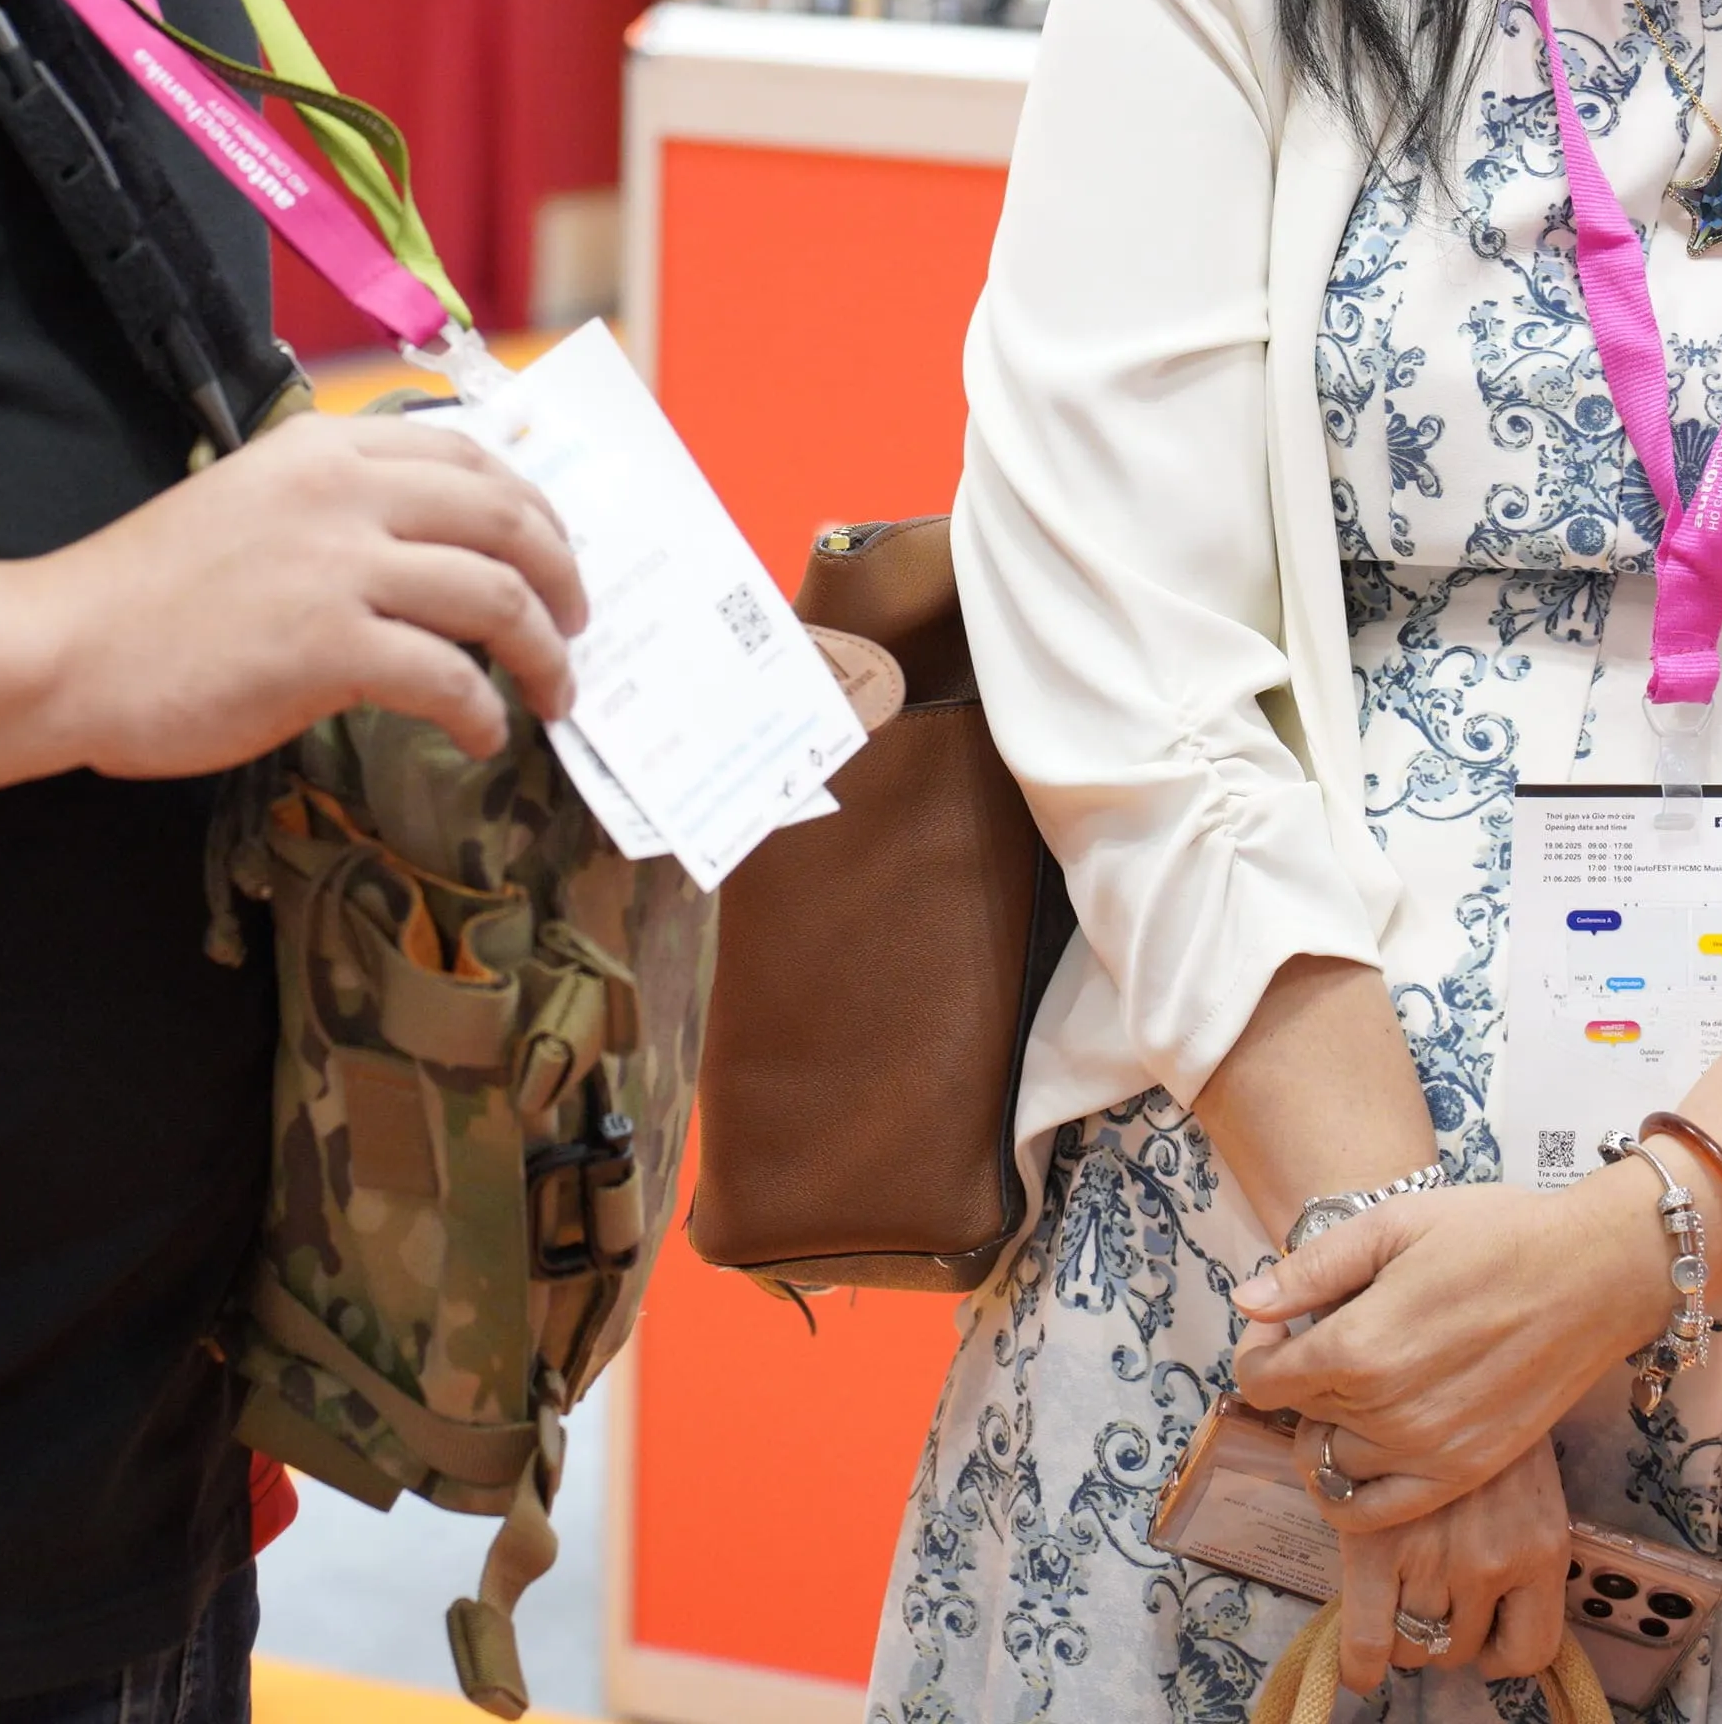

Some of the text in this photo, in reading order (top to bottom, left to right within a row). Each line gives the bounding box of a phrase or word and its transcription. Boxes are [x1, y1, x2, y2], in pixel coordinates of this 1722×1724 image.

[134, 48, 296, 210] automechanika
[1707, 510, 1721, 531] HO
[1545, 824, 1576, 832] Opening
[1587, 842, 1608, 850] 09:00
[1614, 842, 1633, 850] 17:00
[1543, 853, 1633, 861] 20.06.2025 09:00 17:00
